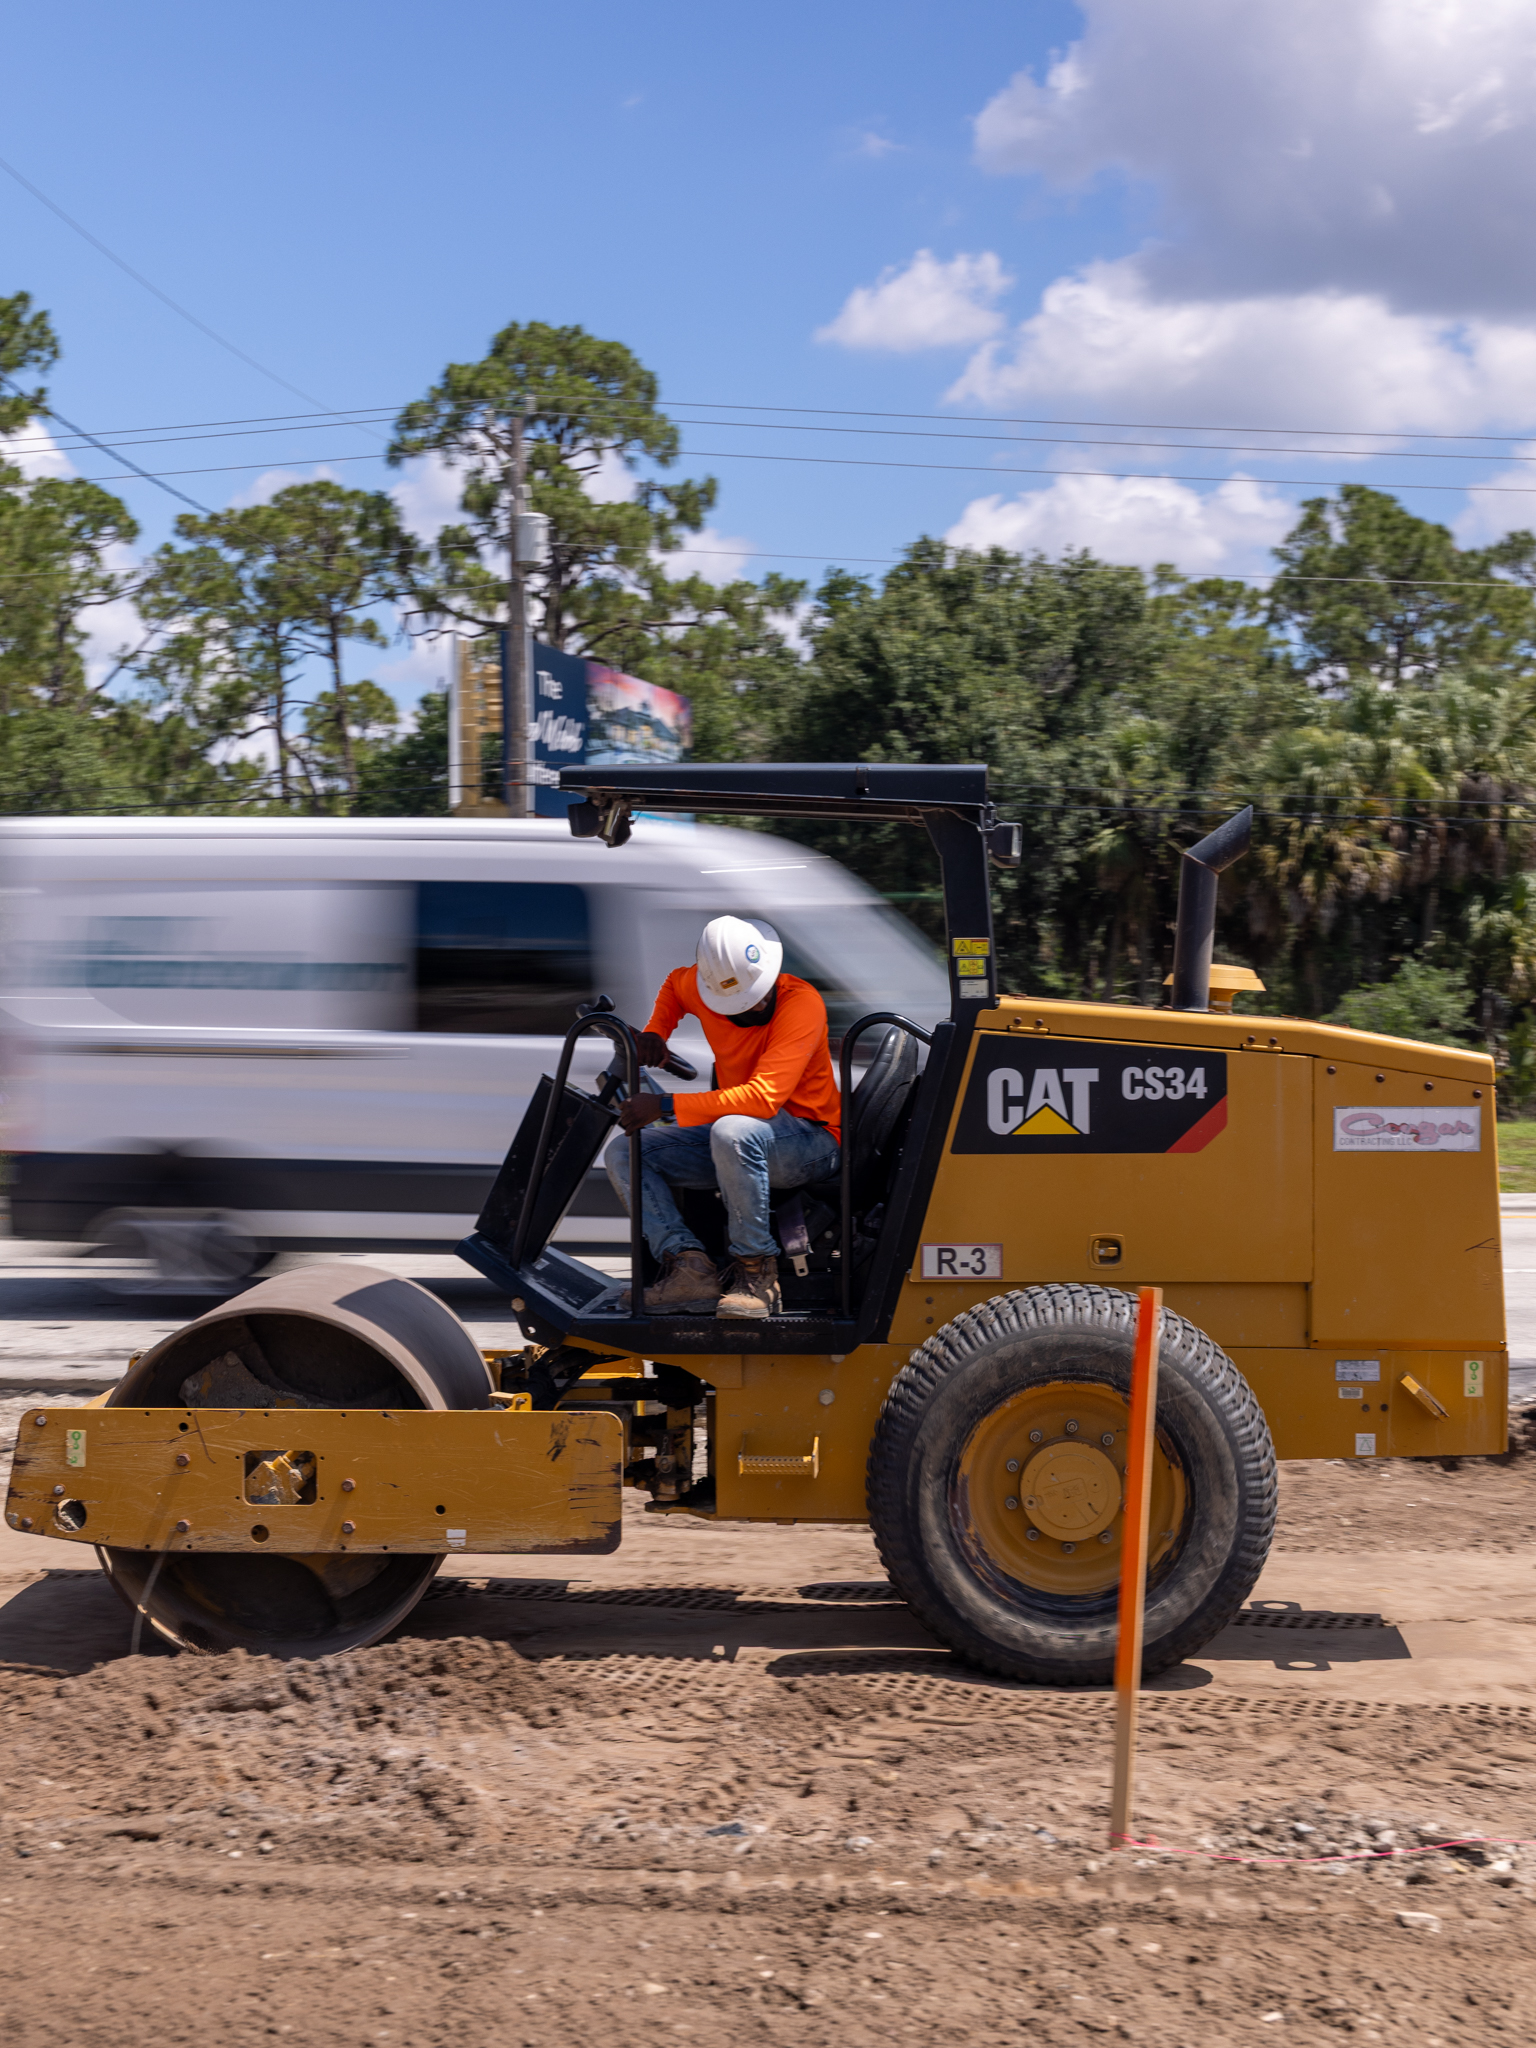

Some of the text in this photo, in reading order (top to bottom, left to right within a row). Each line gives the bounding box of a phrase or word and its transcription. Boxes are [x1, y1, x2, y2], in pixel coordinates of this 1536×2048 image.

[536, 670, 564, 700] The
[987, 1066, 1208, 1135] CAT CS34
[1339, 1137, 1413, 1146] CONTRACTING LLC
[1340, 1112, 1475, 1145] Cougar
[936, 1247, 987, 1276] R-3
